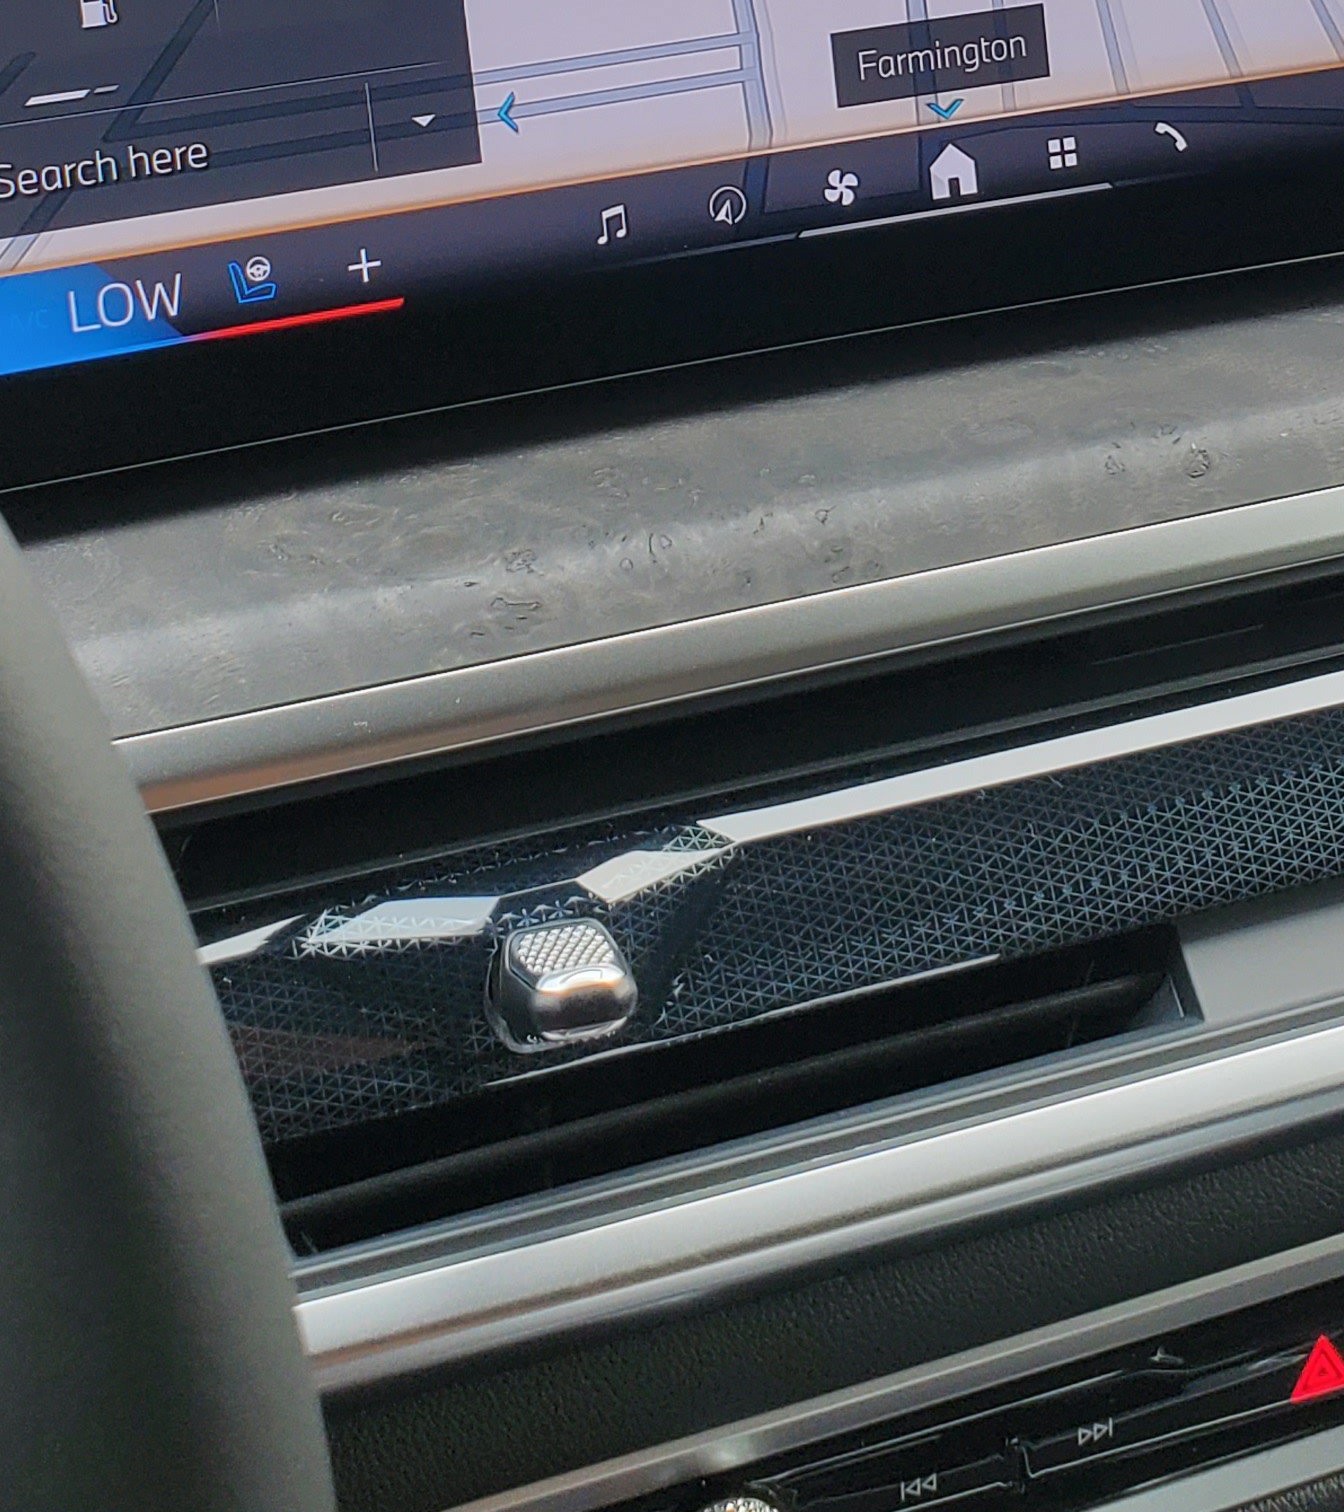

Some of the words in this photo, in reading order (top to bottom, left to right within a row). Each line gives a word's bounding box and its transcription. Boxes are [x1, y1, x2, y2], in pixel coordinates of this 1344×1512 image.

[858, 35, 1027, 81] Farmington
[128, 142, 208, 178] here
[67, 273, 182, 333] LOW
